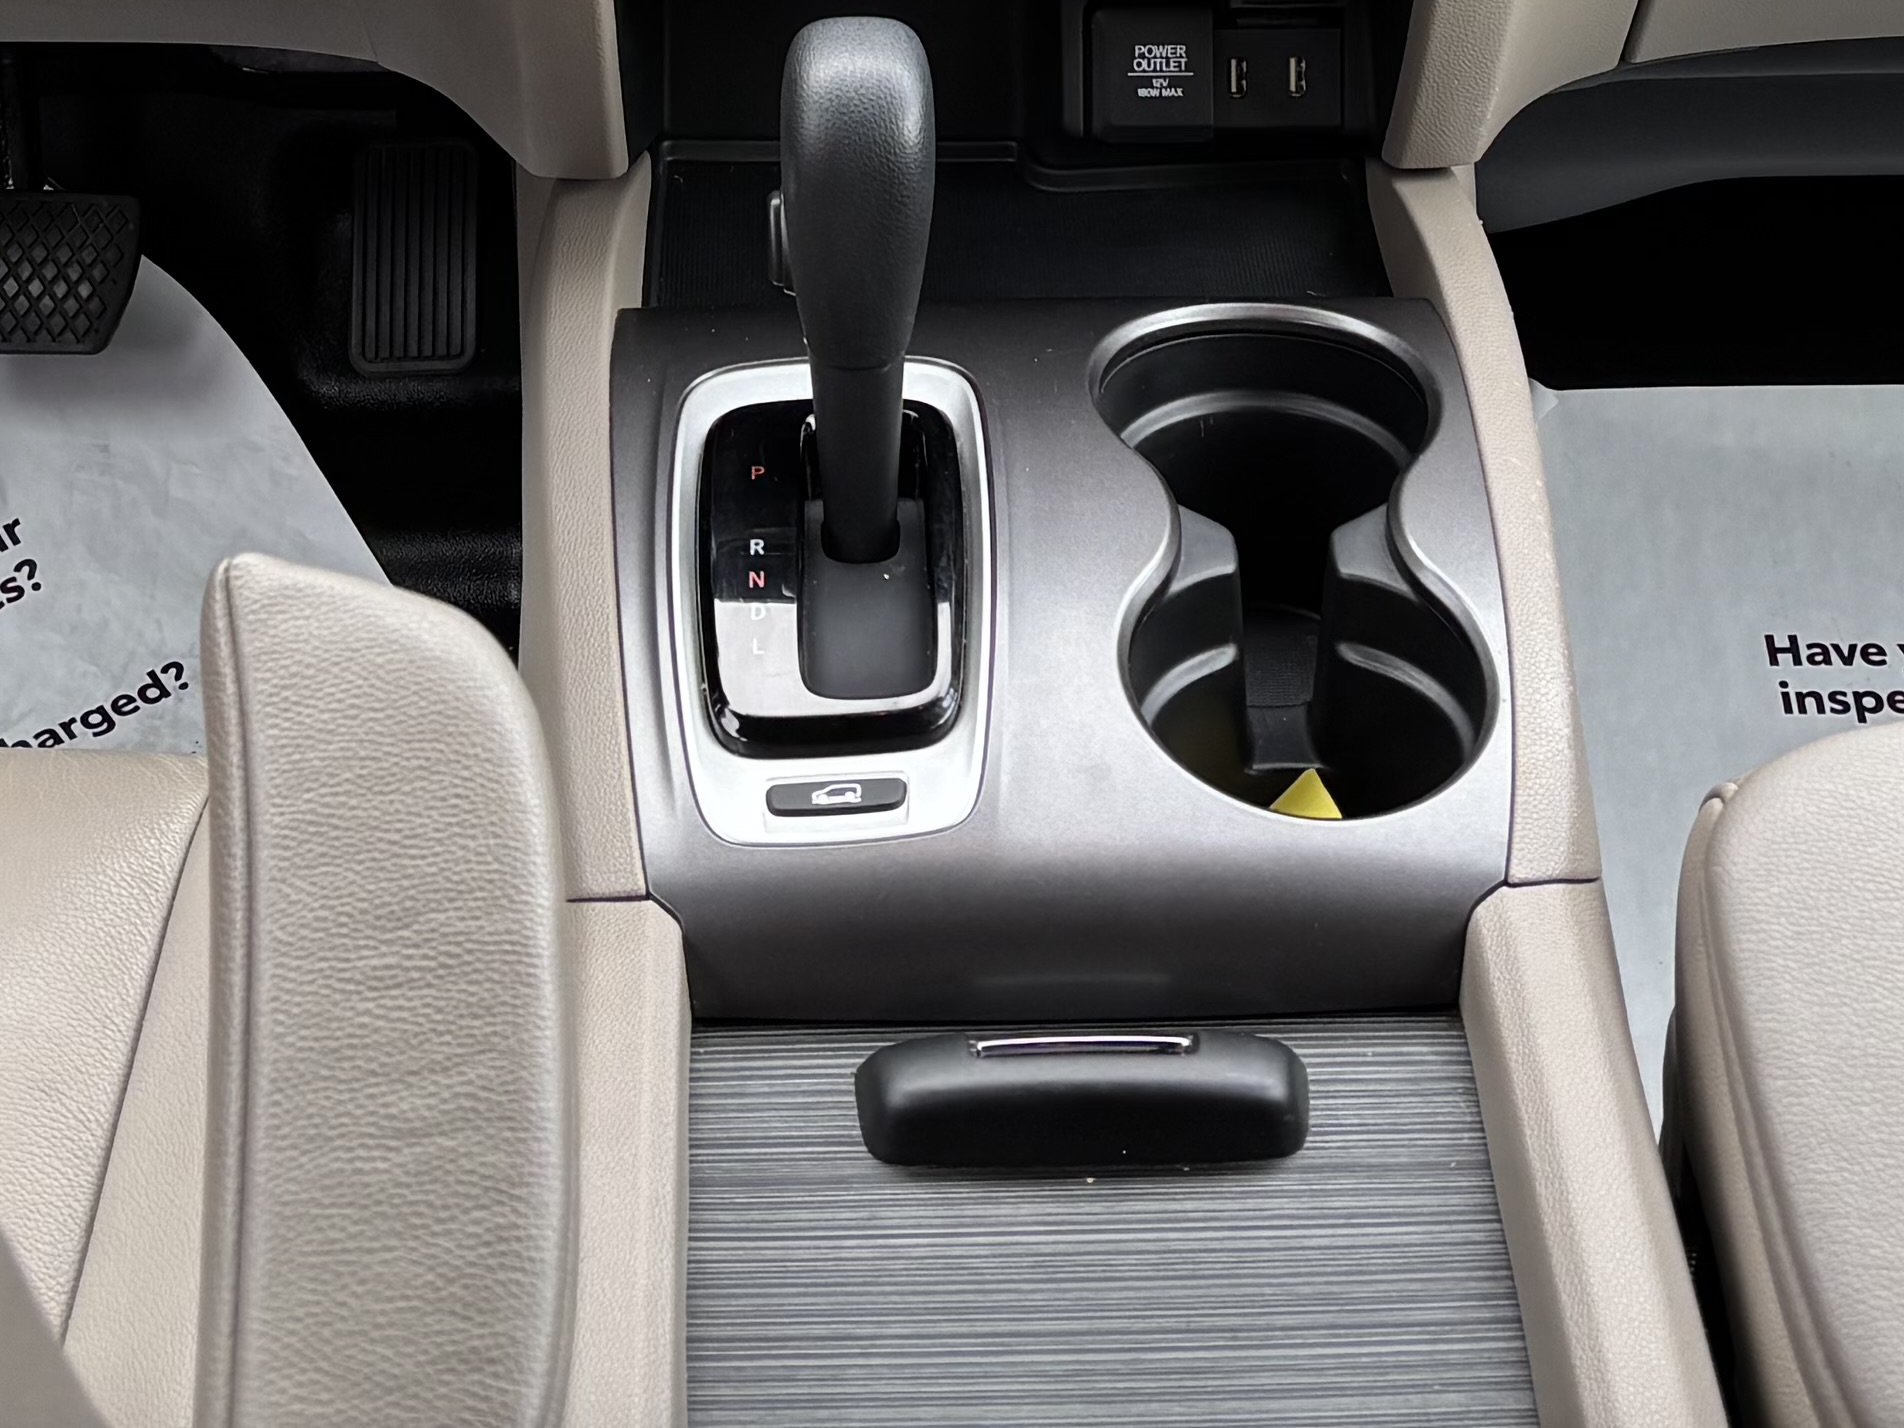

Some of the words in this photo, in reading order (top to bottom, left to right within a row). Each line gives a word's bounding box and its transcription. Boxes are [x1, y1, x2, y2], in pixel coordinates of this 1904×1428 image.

[1134, 44, 1187, 58] POWER
[1132, 58, 1188, 72] OUTLET
[1161, 87, 1184, 98] MAX
[750, 466, 765, 481] P
[748, 538, 765, 556] R
[748, 570, 765, 588] N
[750, 603, 767, 621] D
[752, 637, 765, 655] L
[1764, 633, 1888, 668] Have
